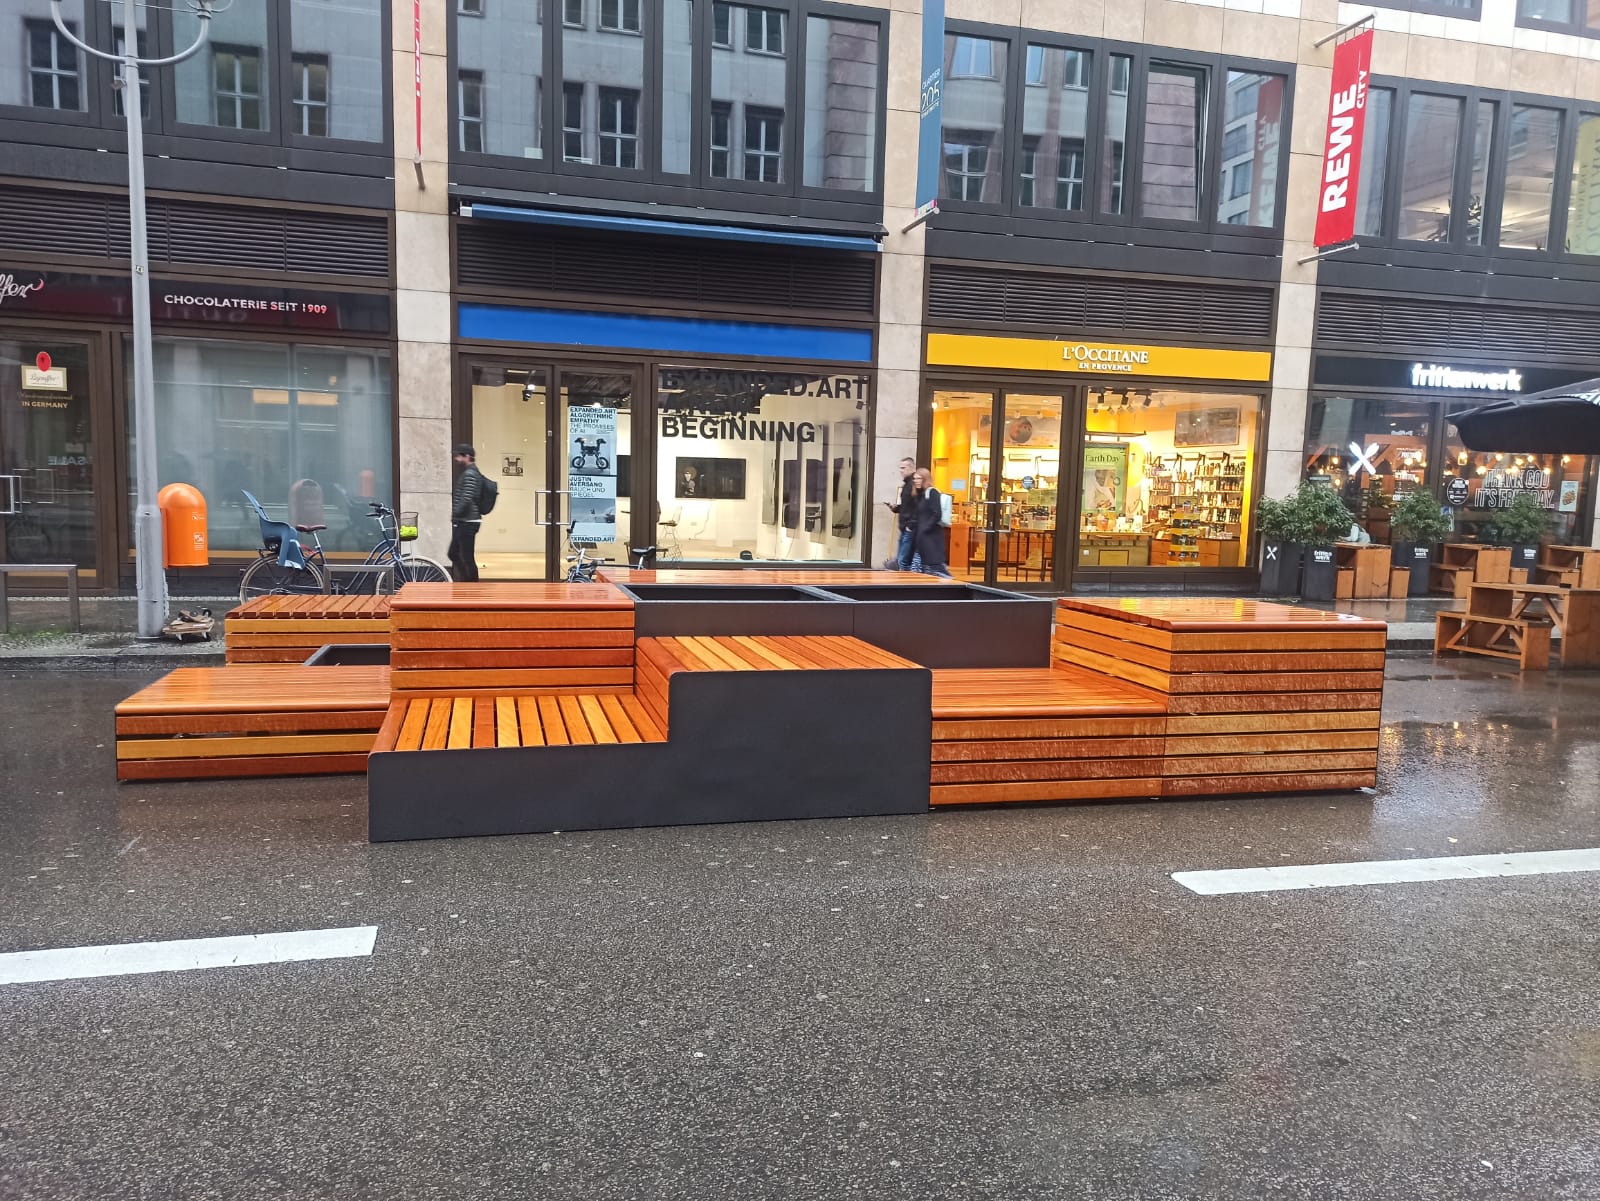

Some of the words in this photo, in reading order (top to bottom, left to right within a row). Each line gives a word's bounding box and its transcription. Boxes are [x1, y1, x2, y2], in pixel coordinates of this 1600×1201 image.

[921, 79, 940, 111] 205
[1356, 70, 1367, 109] CITY
[1322, 84, 1357, 212] REWE
[163, 294, 268, 310] CHOCOLATERIE
[270, 301, 299, 312] SEIT
[302, 303, 328, 314] 1909
[1062, 345, 1149, 363] L'OCCITANE
[1091, 363, 1133, 372] PROVENCE
[31, 401, 68, 409] GERMANY
[661, 416, 815, 443] BEGINNING
[1525, 469, 1551, 489] GOD
